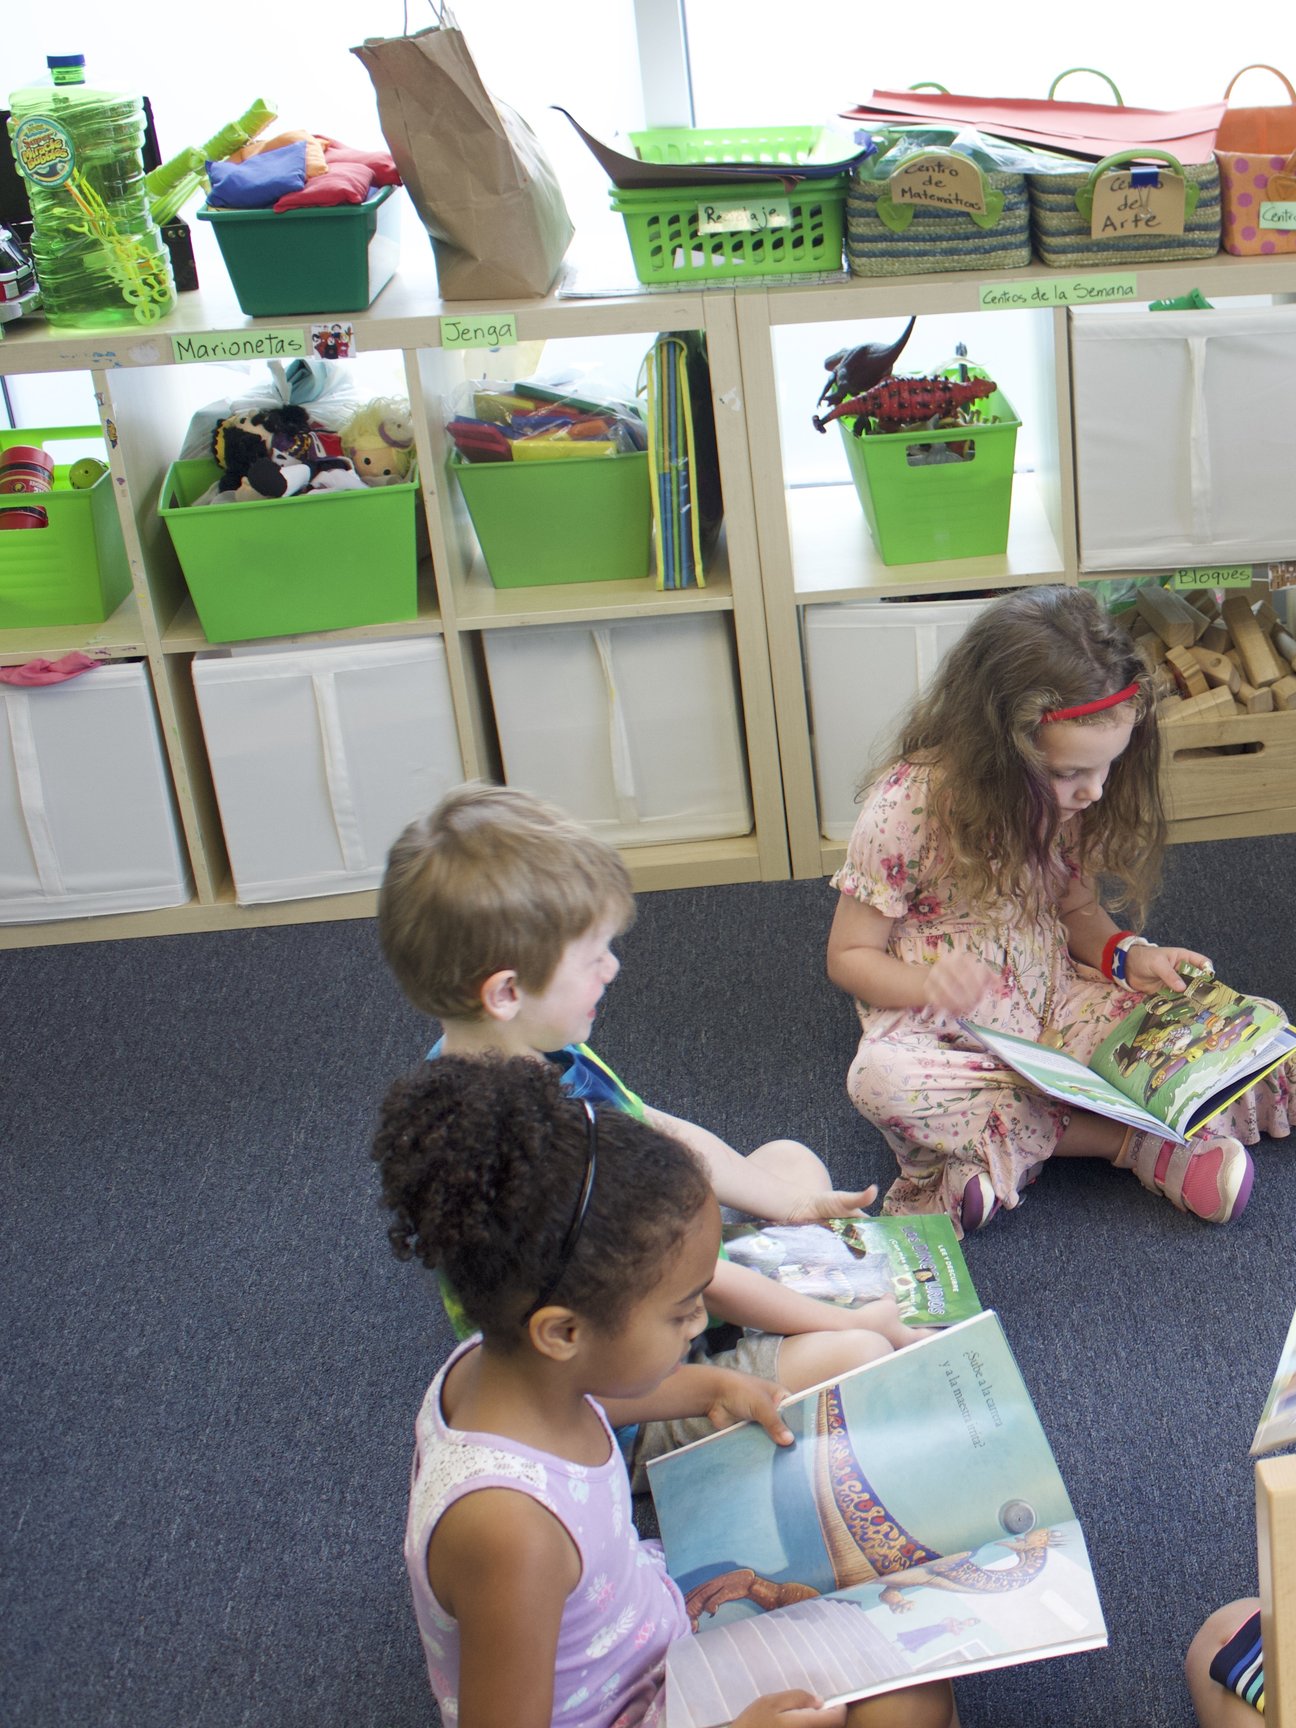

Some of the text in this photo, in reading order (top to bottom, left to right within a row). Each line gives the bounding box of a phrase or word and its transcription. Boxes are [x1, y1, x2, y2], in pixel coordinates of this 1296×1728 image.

[904, 161, 959, 177] Centro
[922, 175, 947, 188] de
[1117, 194, 1142, 211] de
[1102, 213, 1161, 232] Arte
[982, 283, 1134, 305] Centros de la Semana
[176, 321, 513, 361] Marionetas Jenga
[1179, 569, 1250, 585] Bloques
[938, 1244, 949, 1256] LEE
[945, 1260, 959, 1292] DESCUBRE
[939, 1360, 950, 1368] y
[963, 1350, 984, 1378] ¿Sube
[945, 1369, 953, 1377] a
[948, 1375, 960, 1388] la
[982, 1385, 993, 1397] la
[953, 1388, 972, 1423] maestra
[986, 1398, 1003, 1428] carrera
